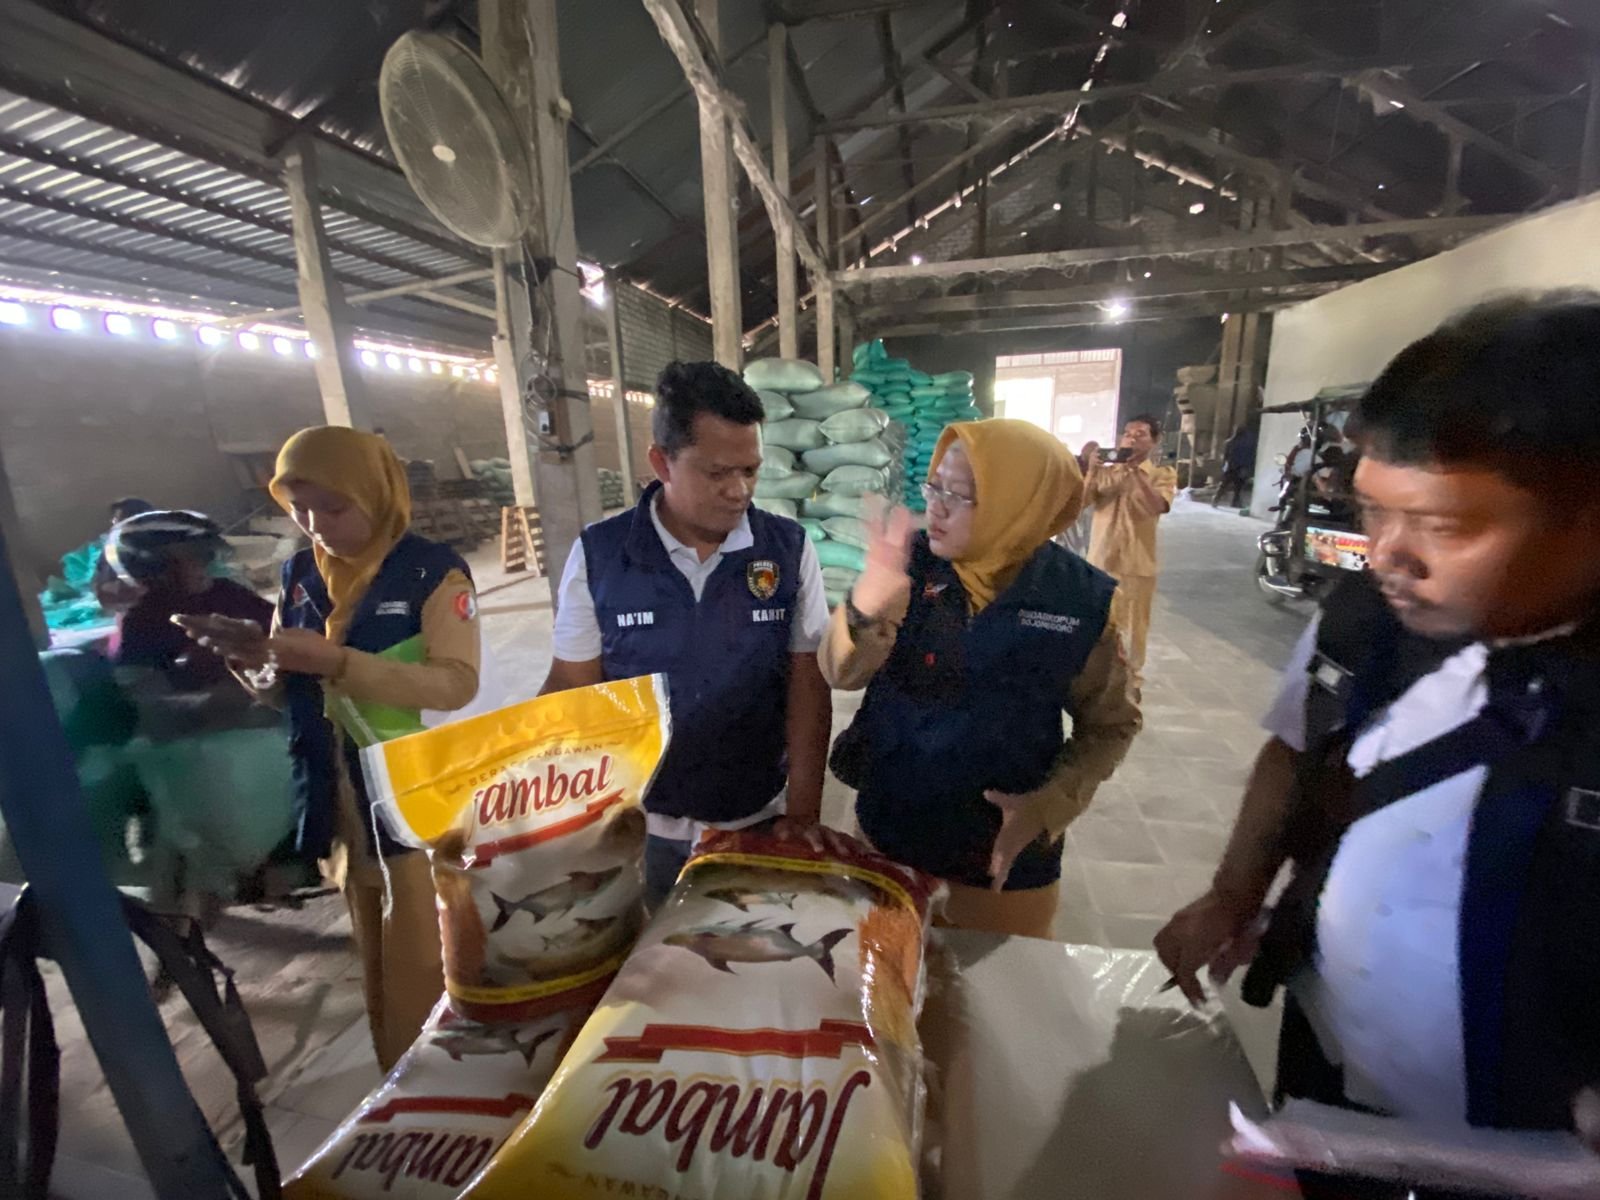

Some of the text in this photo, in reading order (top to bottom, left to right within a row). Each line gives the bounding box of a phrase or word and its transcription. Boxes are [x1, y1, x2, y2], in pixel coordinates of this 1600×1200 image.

[616, 611, 654, 627] NA'IM
[475, 754, 611, 827] ambal
[331, 1131, 493, 1192] ambal
